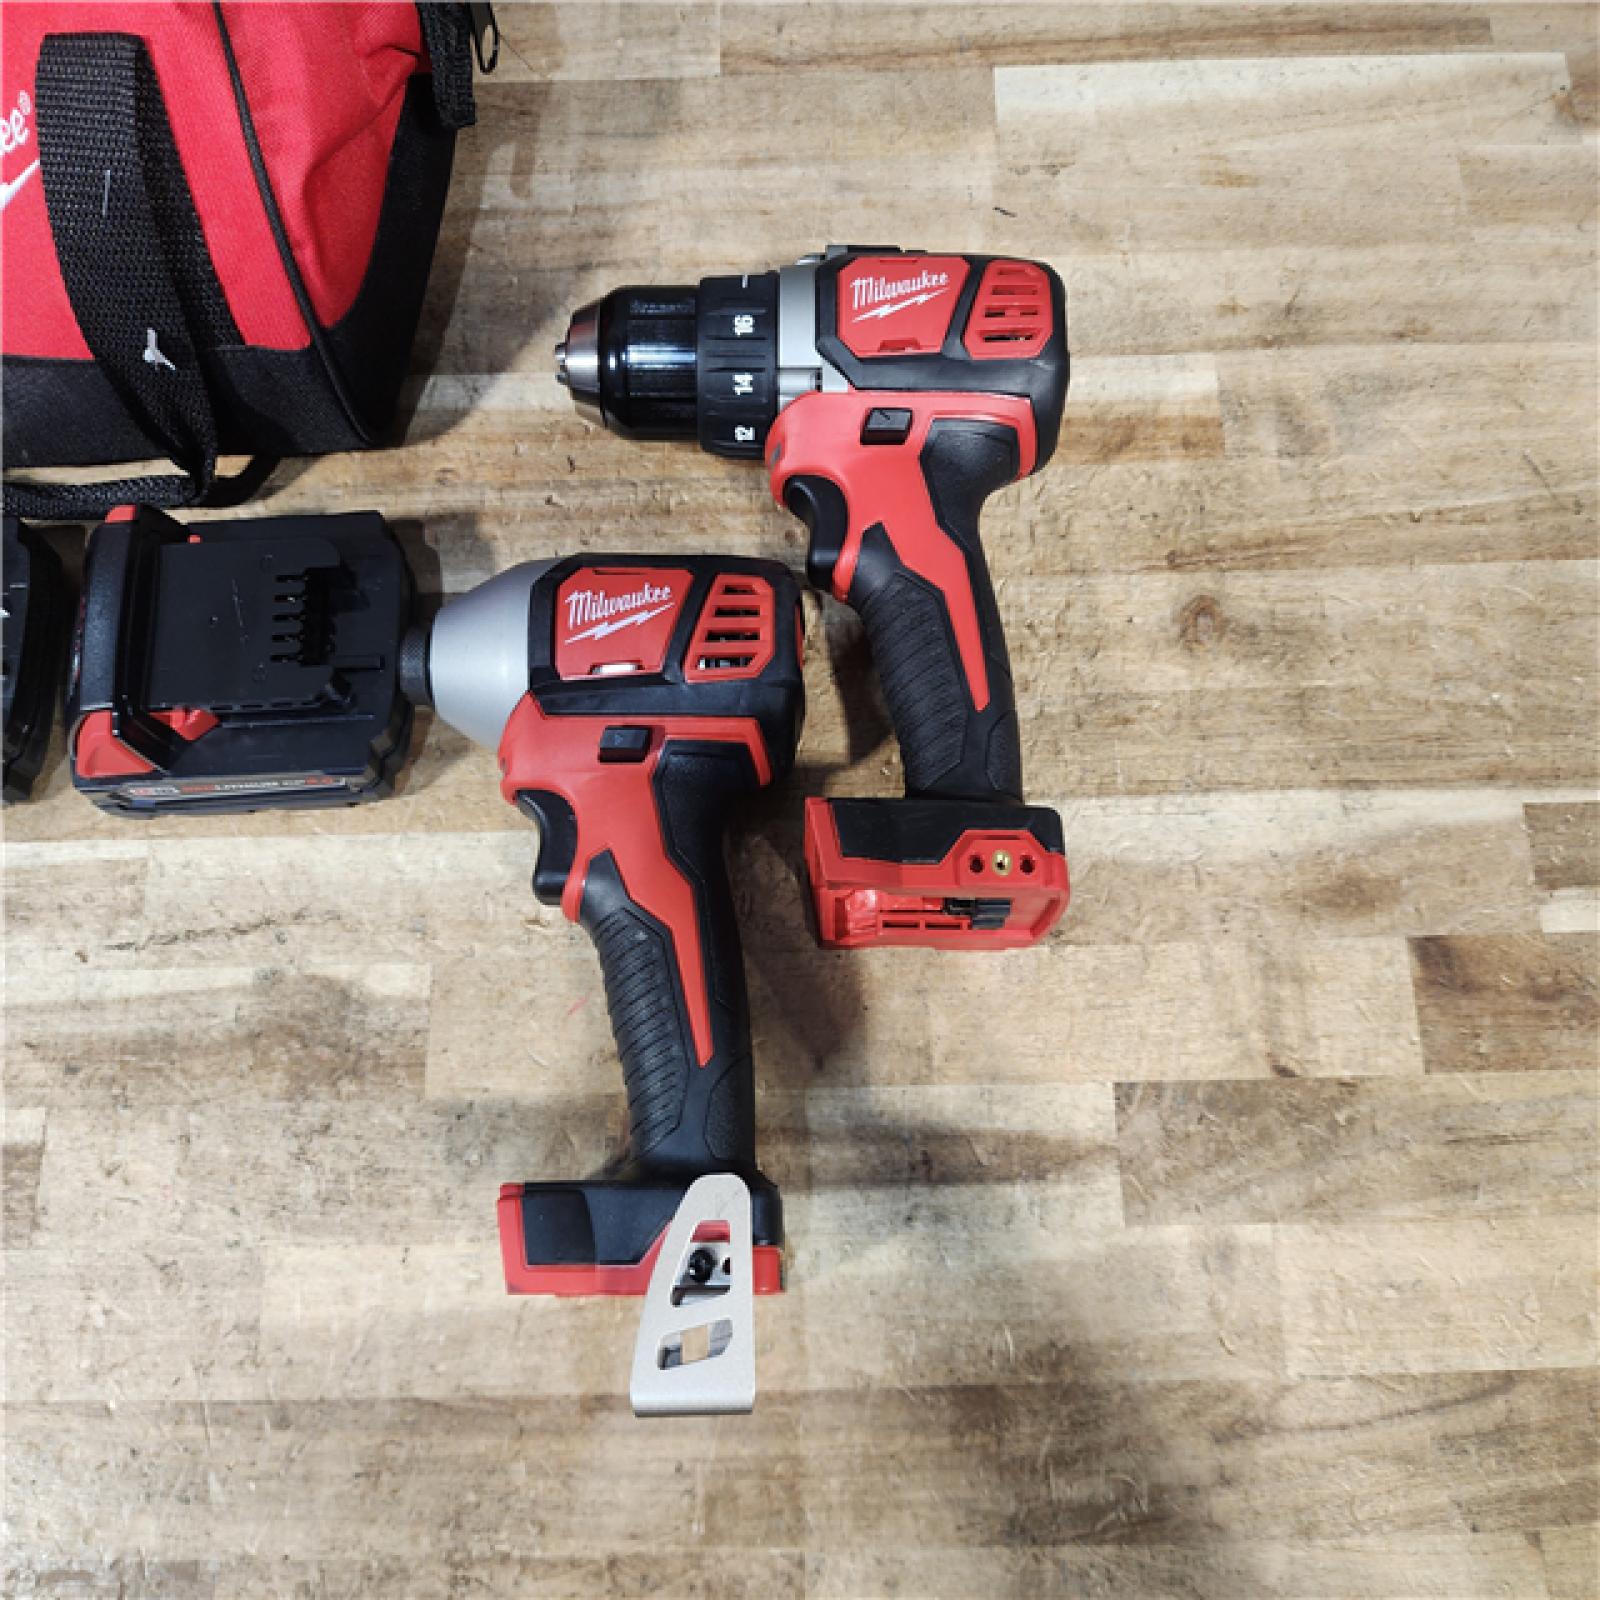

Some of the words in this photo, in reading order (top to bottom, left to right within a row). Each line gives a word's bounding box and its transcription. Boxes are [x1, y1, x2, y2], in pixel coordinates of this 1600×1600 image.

[850, 269, 950, 310] Milwaukee
[733, 314, 755, 335] 16
[732, 373, 754, 395] 14
[564, 581, 672, 630] Milwaukee
